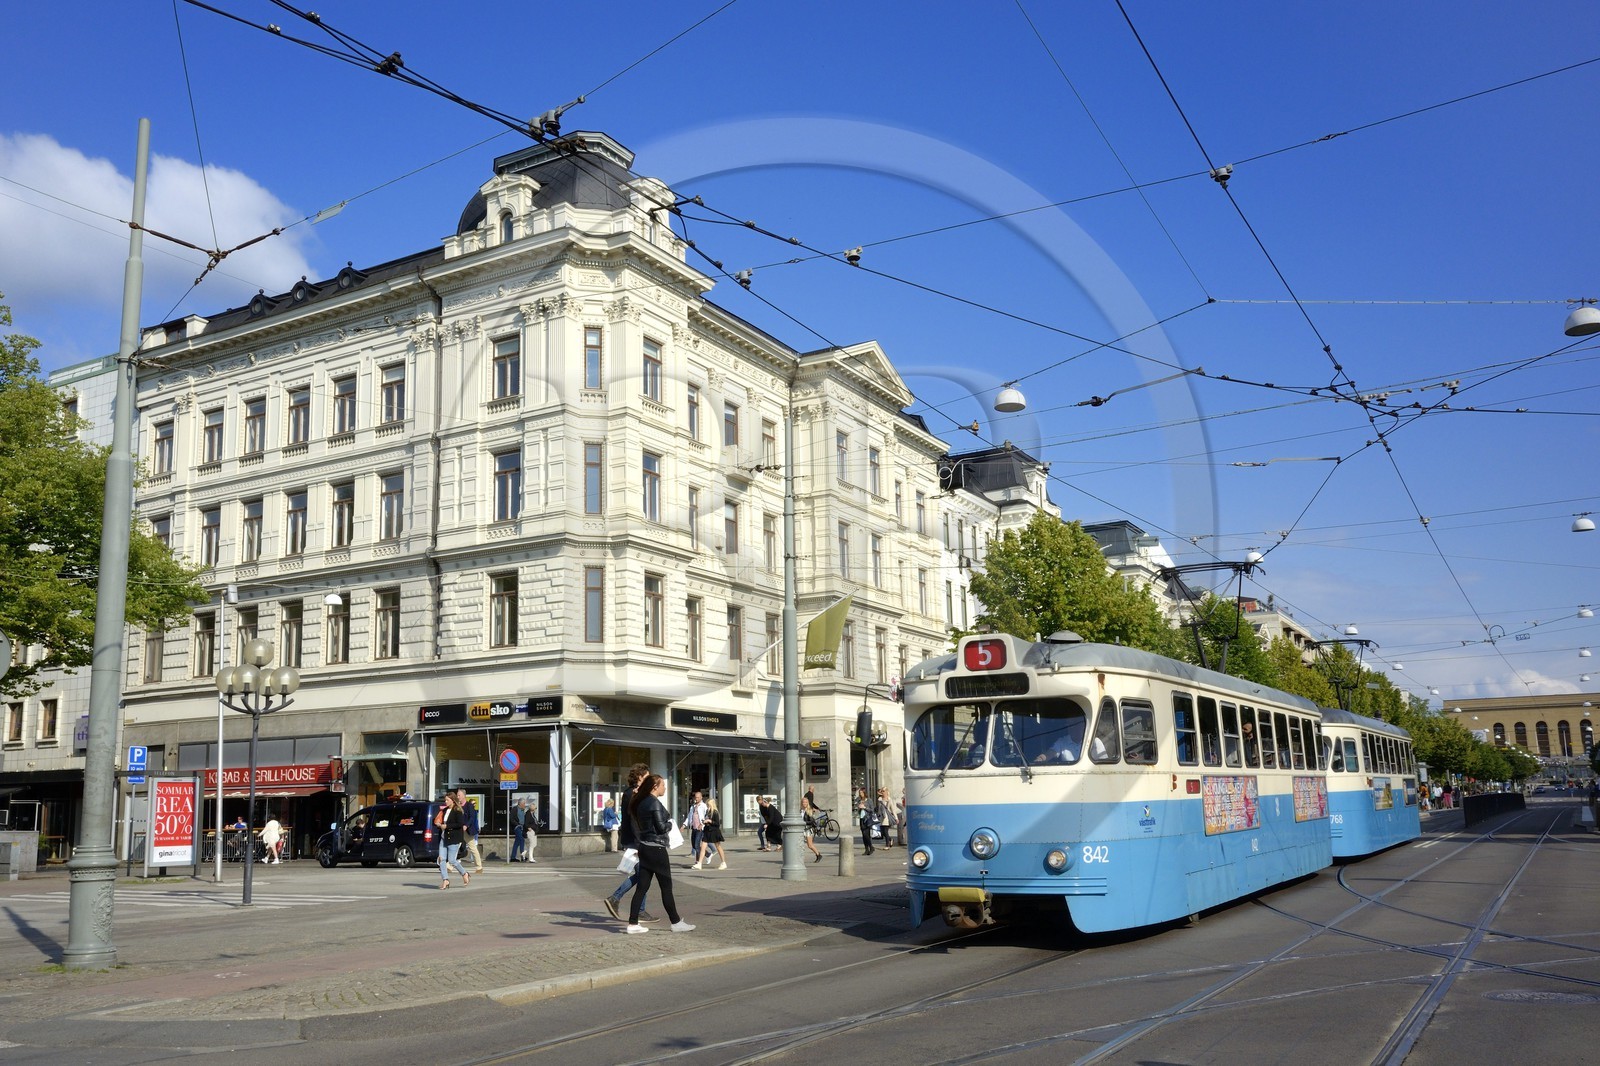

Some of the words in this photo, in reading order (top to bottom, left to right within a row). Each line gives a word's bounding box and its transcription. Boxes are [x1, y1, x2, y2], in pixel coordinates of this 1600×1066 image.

[978, 641, 992, 666] 5
[424, 710, 440, 718] ecco
[471, 704, 510, 717] dinsko
[134, 748, 143, 762] P
[243, 770, 250, 782] &
[156, 786, 194, 796] SOMMAR
[157, 796, 193, 813] REA
[154, 814, 193, 835] 50%
[1082, 845, 1110, 863] 842
